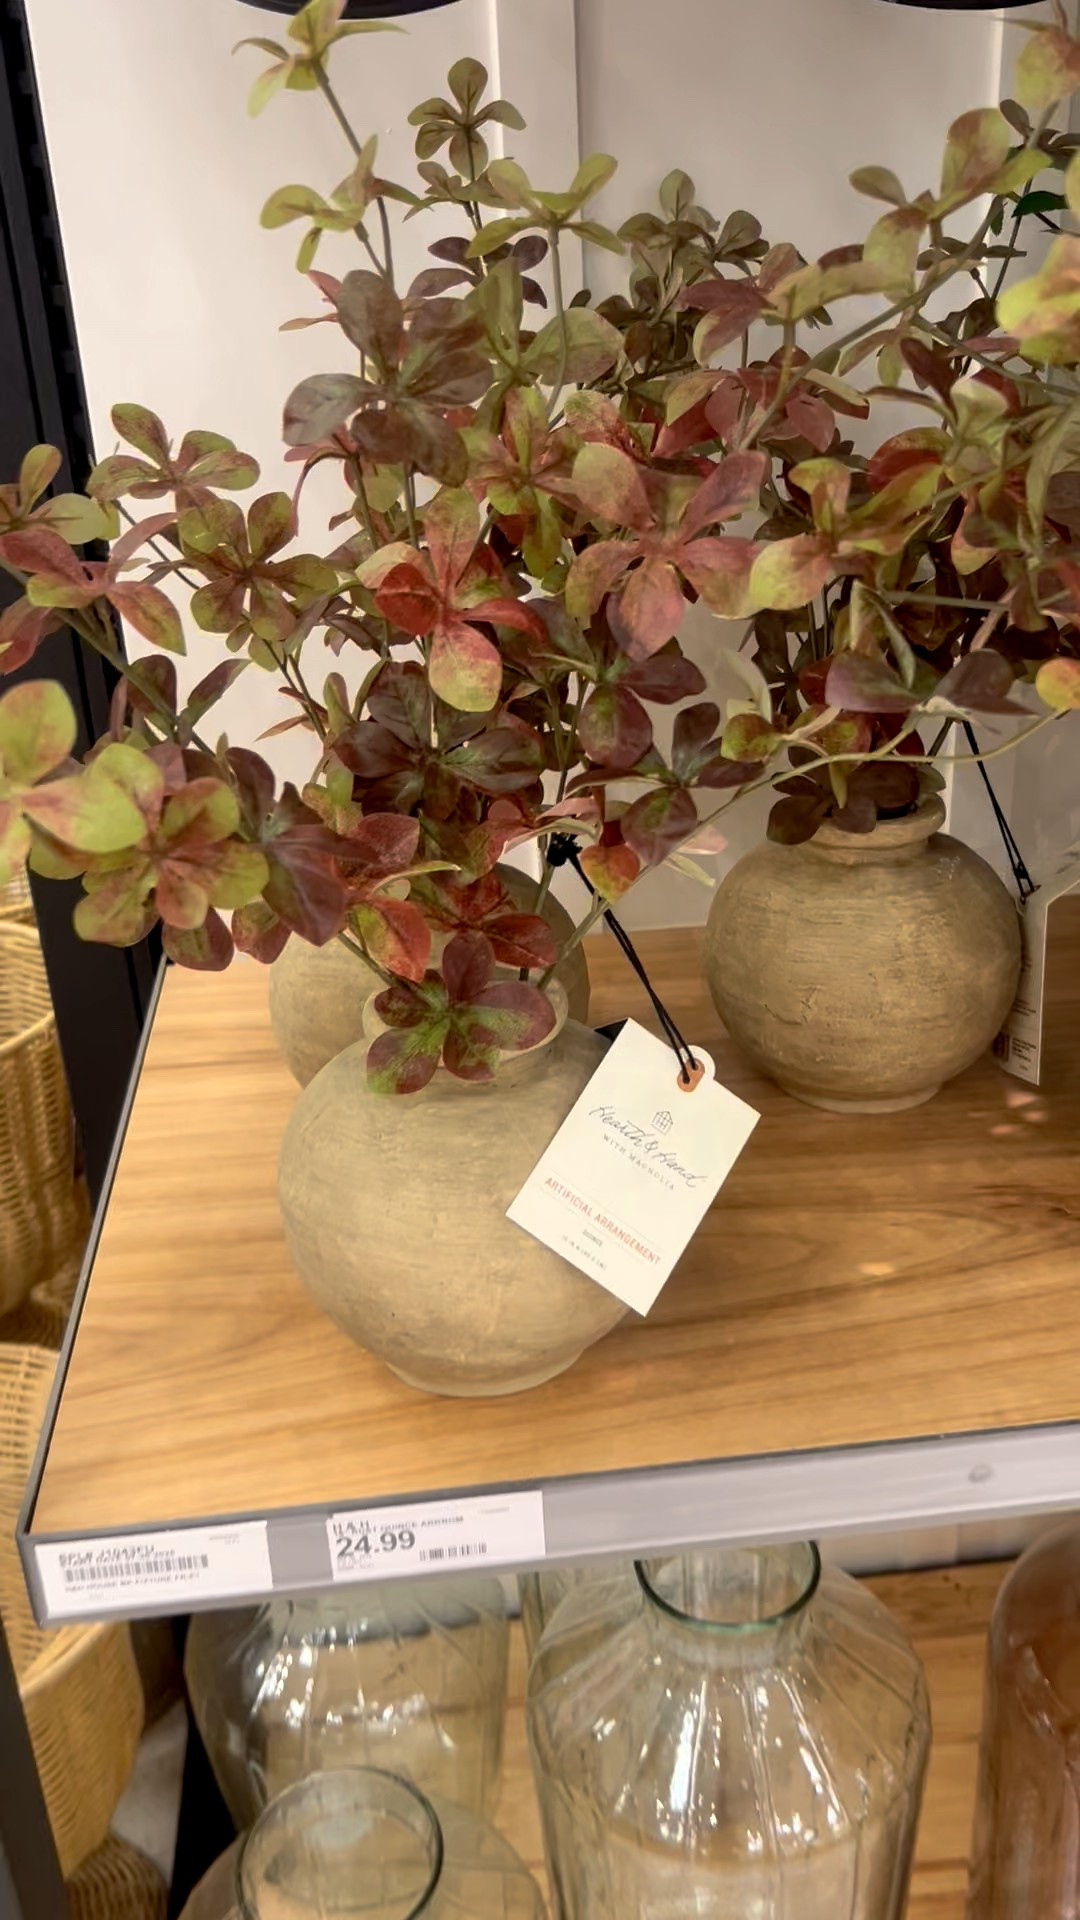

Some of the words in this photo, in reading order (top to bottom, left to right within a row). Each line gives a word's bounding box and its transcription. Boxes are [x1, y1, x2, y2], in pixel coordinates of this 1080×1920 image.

[589, 1104, 646, 1149] Hearth
[643, 1139, 659, 1154] &
[652, 1149, 708, 1188] Hand
[603, 1133, 627, 1158] WITH
[628, 1152, 675, 1191] MAGNOLIA
[544, 1176, 593, 1217] ARTIFICIAL
[593, 1212, 662, 1266] ARRANGEMENT
[336, 1529, 416, 1559] 24.99
